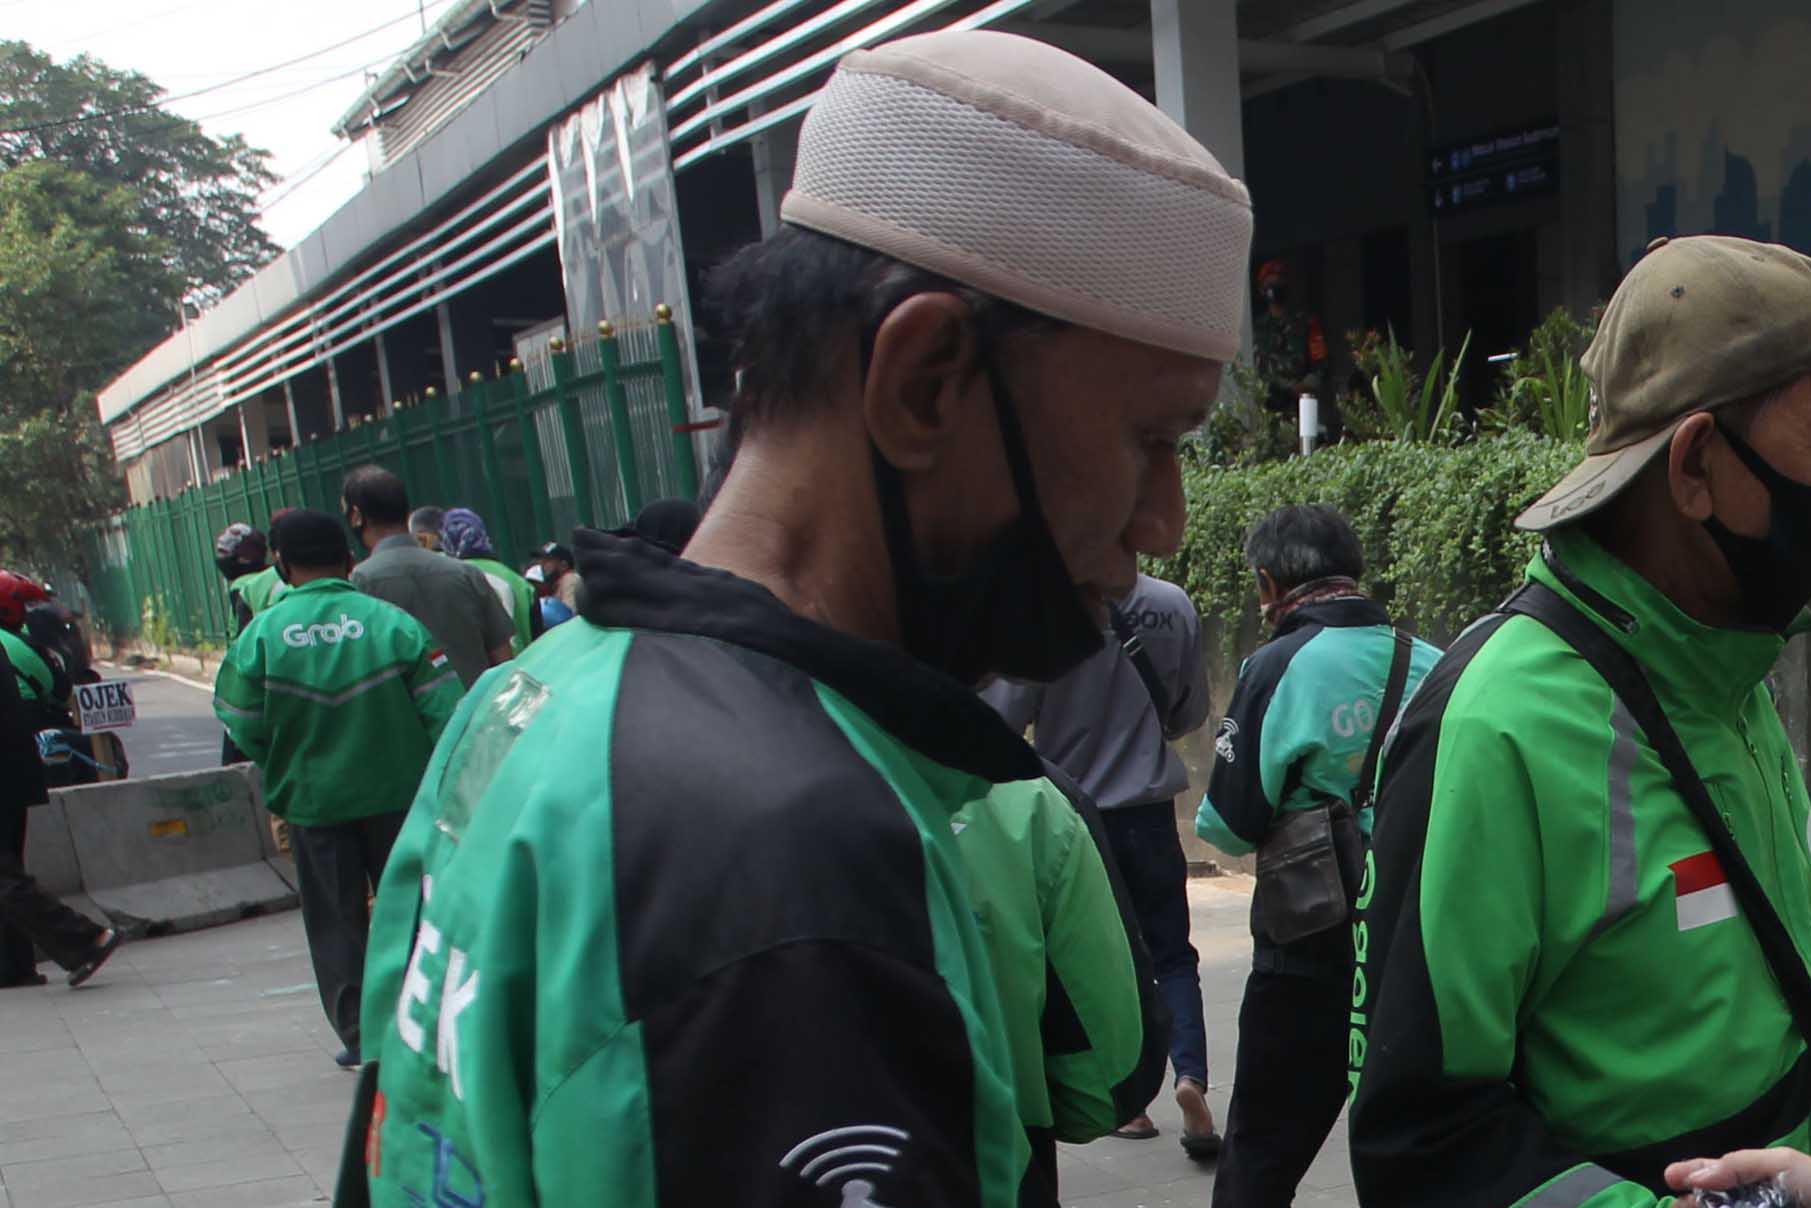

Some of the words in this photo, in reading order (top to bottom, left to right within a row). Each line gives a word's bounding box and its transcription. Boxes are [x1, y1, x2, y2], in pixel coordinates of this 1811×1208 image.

[283, 613, 364, 648] Grab
[80, 682, 133, 710] OJEK
[397, 919, 479, 1101] EK
